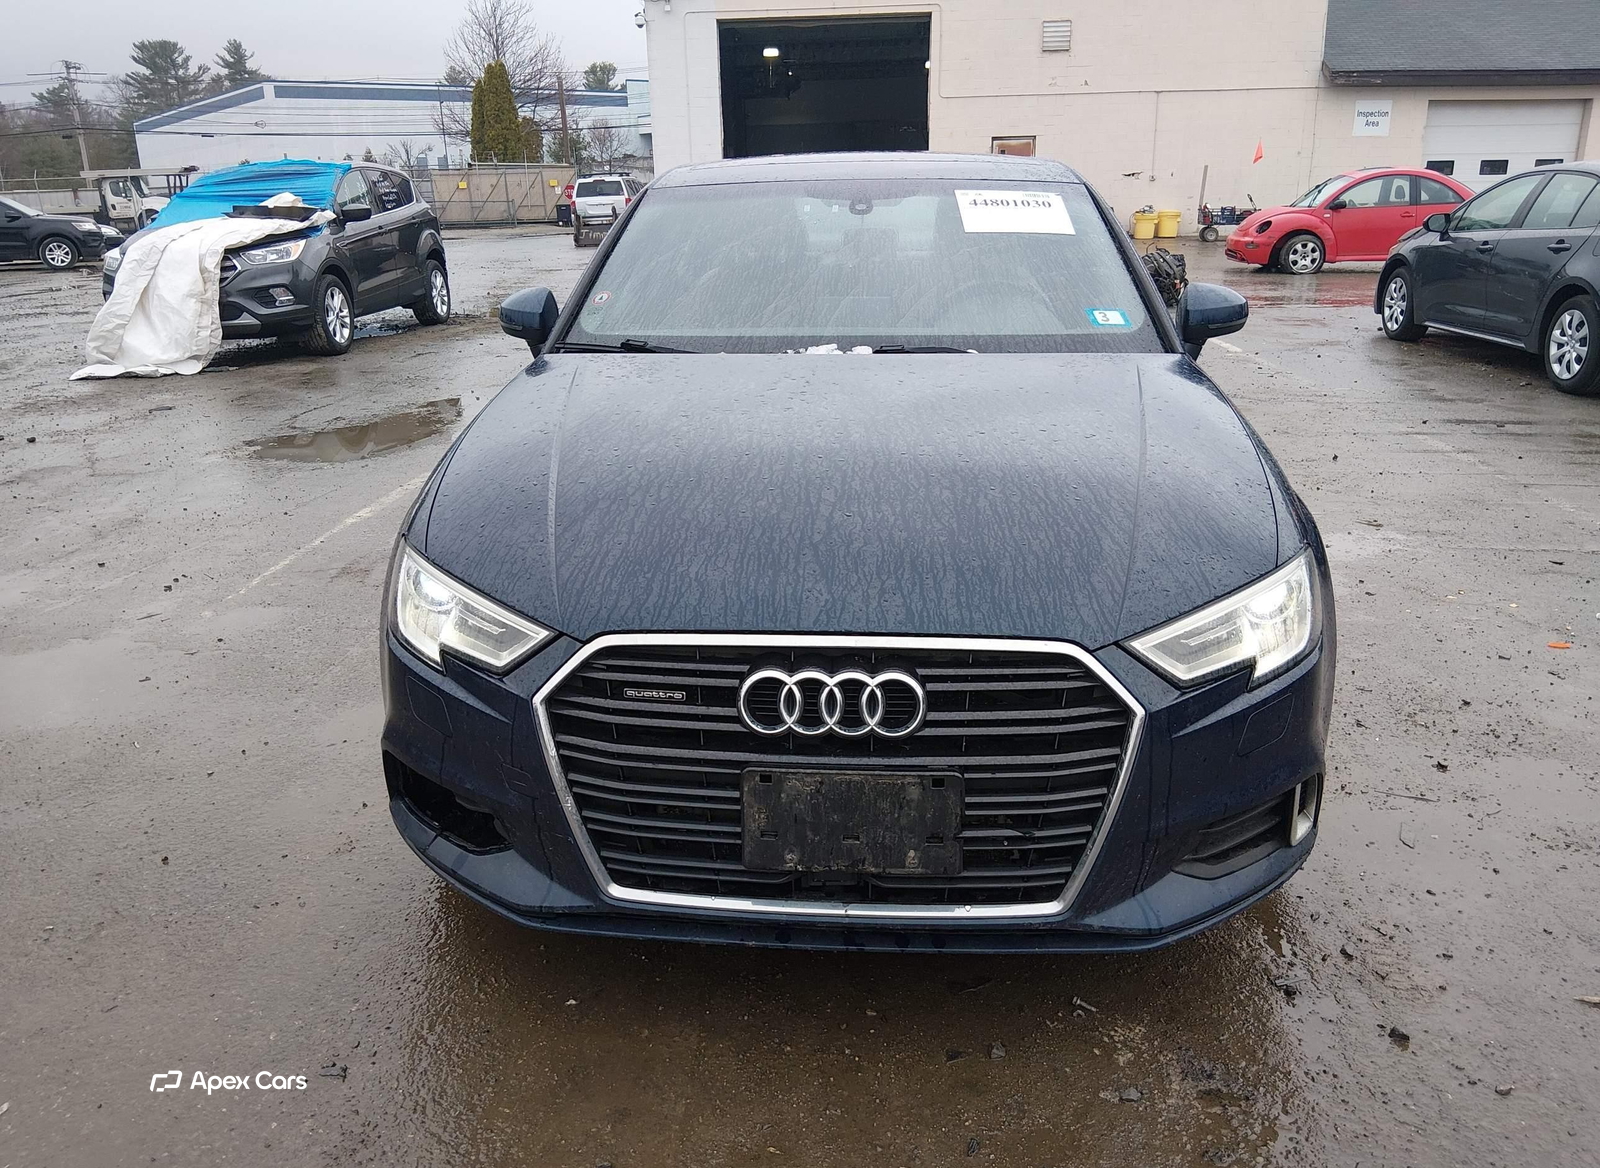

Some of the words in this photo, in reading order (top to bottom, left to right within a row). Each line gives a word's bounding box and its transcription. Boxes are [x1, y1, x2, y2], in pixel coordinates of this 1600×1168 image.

[1356, 109, 1389, 119] Inspection
[1364, 119, 1380, 127] Area
[968, 198, 1052, 208] 44801030
[1098, 311, 1110, 322] 3
[626, 690, 683, 699] quattro
